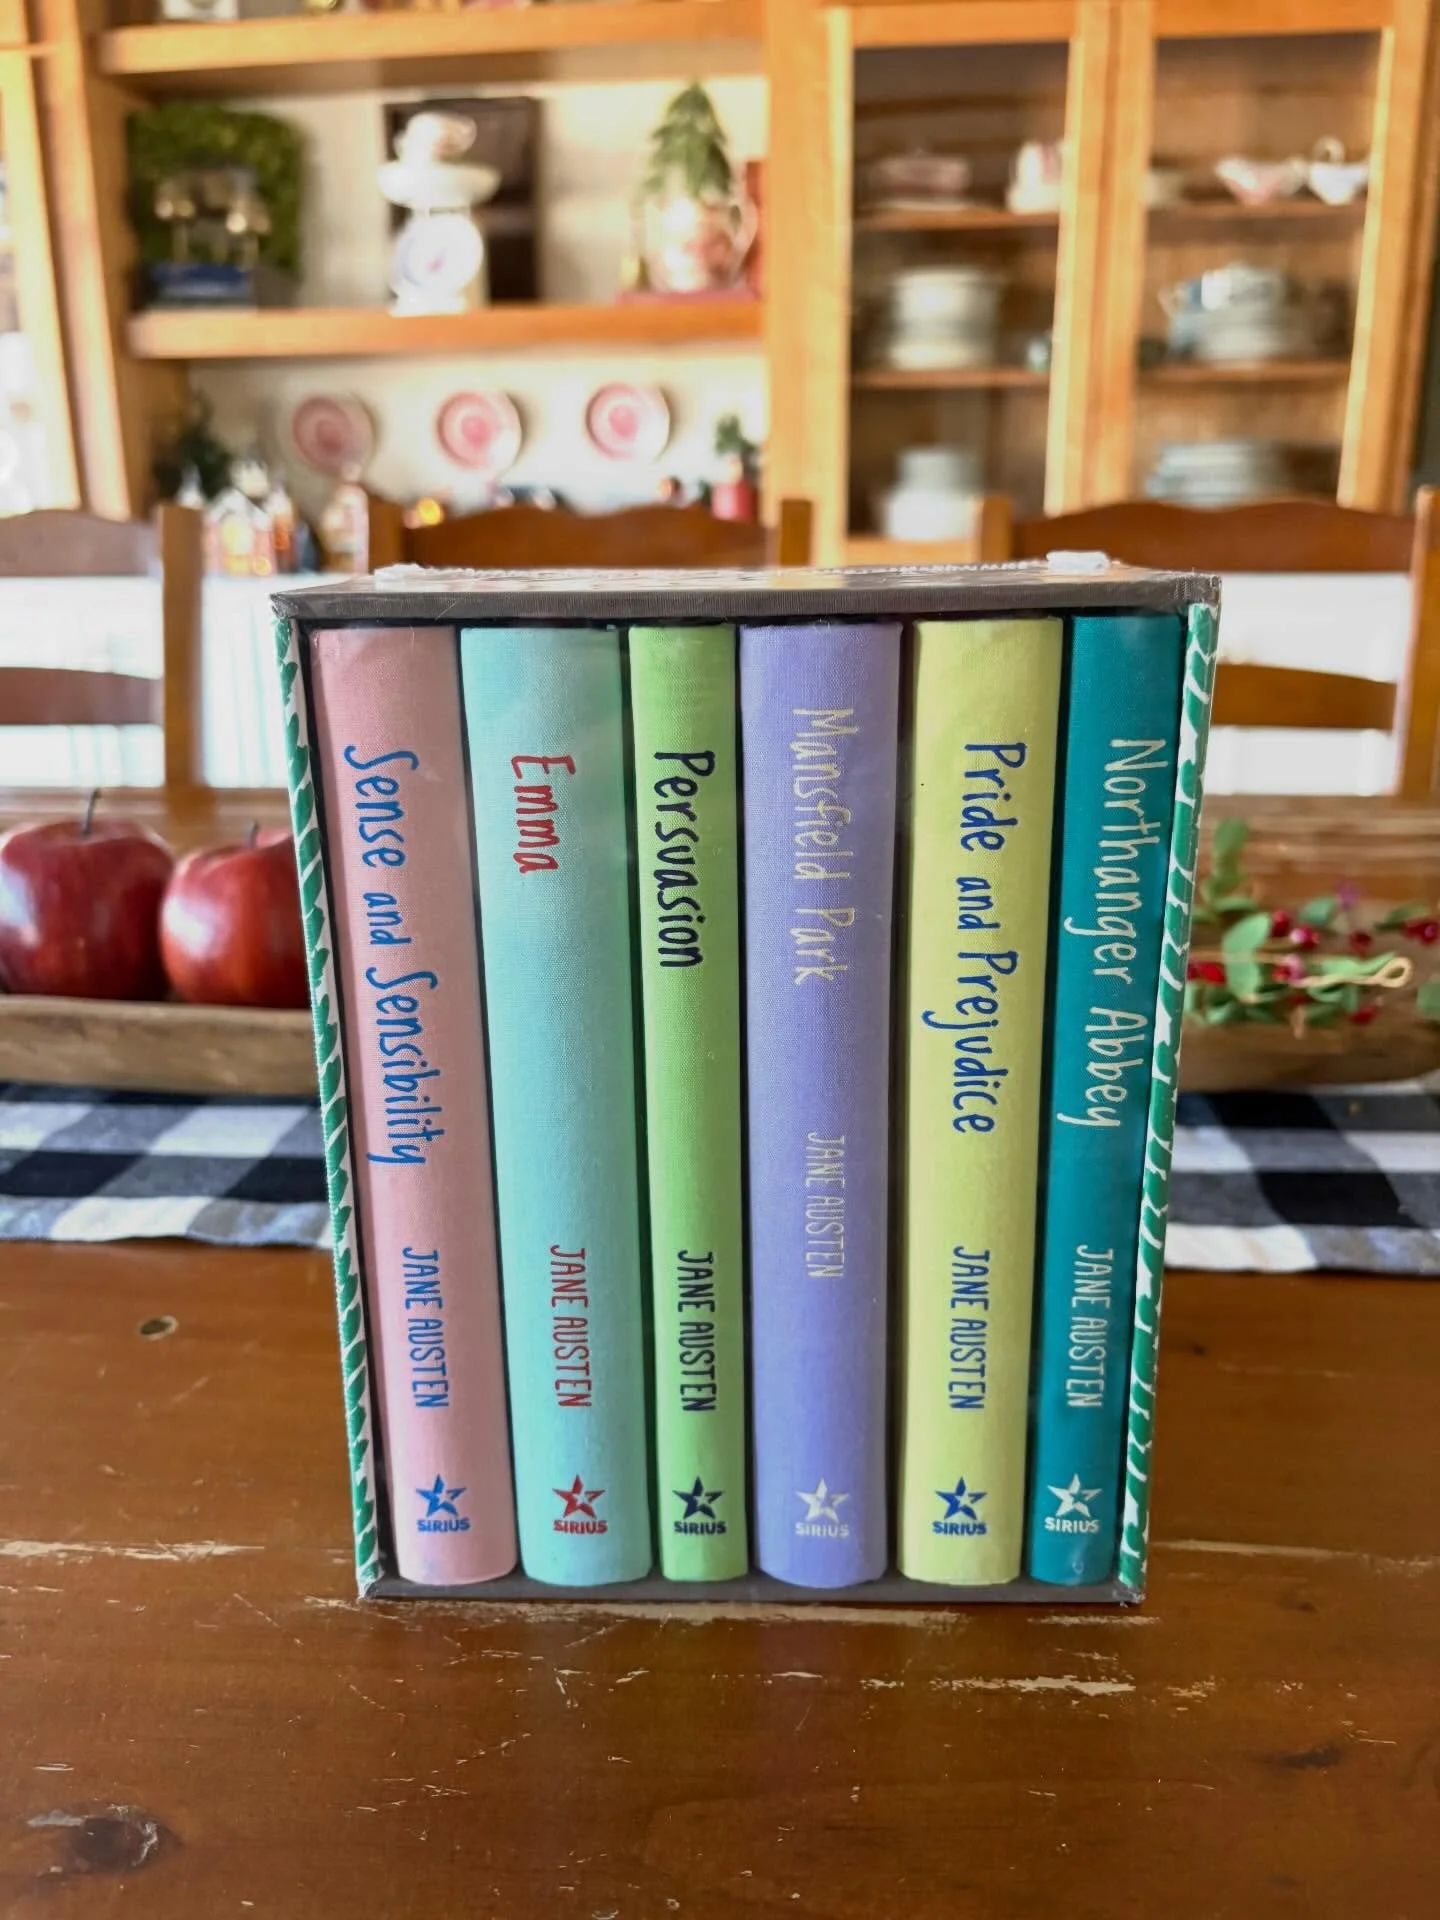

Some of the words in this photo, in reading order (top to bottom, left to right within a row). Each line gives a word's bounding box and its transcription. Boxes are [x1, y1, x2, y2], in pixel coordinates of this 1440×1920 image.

[343, 744, 419, 869] Sense
[510, 754, 577, 874] Emma
[789, 706, 858, 881] Mansfield
[960, 741, 1027, 852] Pride
[653, 749, 716, 969] Persuasion
[1063, 737, 1169, 985] Northanger
[362, 891, 412, 946] and
[956, 876, 1000, 930] and
[789, 906, 856, 985] Park
[365, 966, 446, 1166] Sensibility
[922, 950, 1019, 1133] Prejudice
[1056, 1006, 1148, 1129] Abbey
[805, 1132, 846, 1189] JANE
[549, 1244, 588, 1309] JANE
[805, 1196, 845, 1279] AUSTEN
[950, 1245, 990, 1311] JANE
[1071, 1244, 1114, 1310] JANE
[402, 1247, 443, 1311] JANE
[677, 1249, 714, 1314] JANE
[406, 1318, 449, 1409] AUSTEN
[553, 1316, 593, 1408] AUSTEN
[677, 1321, 717, 1412] AUSTEN
[948, 1317, 987, 1410] AUSTEN
[1066, 1316, 1108, 1408] AUSTEN
[417, 1516, 471, 1533] SIRIUS
[554, 1518, 608, 1535] SIRIUS
[674, 1519, 727, 1536] SIRIUS
[794, 1521, 850, 1538] SIRIUS
[932, 1518, 987, 1537] SIRIUS
[1045, 1516, 1101, 1534] SIRIUS
